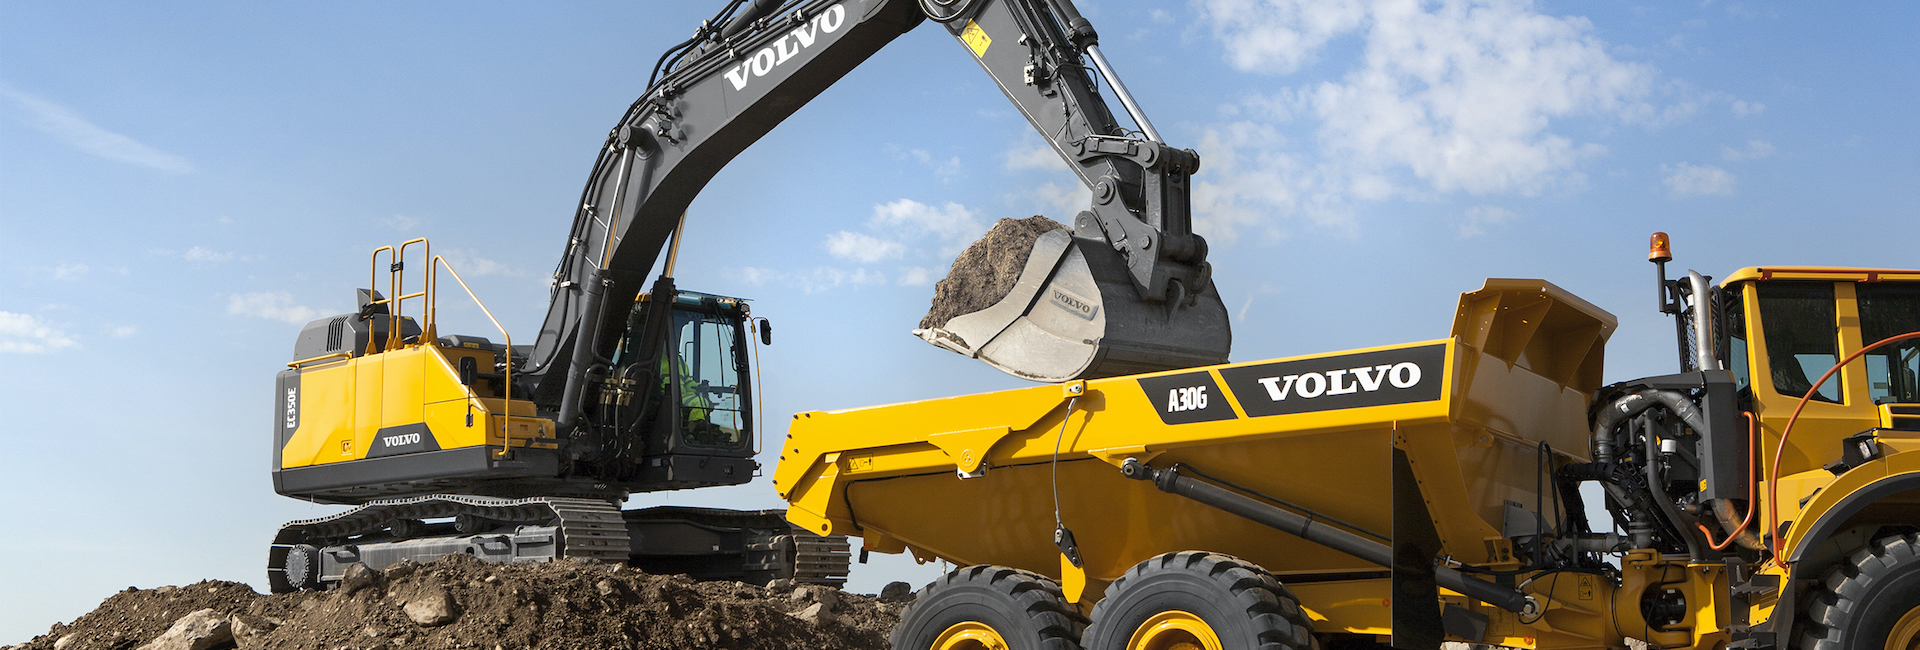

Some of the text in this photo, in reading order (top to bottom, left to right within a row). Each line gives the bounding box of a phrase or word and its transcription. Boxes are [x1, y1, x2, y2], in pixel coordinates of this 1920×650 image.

[724, 3, 845, 91] VOLVO
[1053, 290, 1090, 313] VOLVO
[1258, 362, 1421, 401] VOLVO
[286, 387, 296, 429] EC350E
[1168, 385, 1207, 412] A30G
[383, 433, 420, 447] VOLVO
